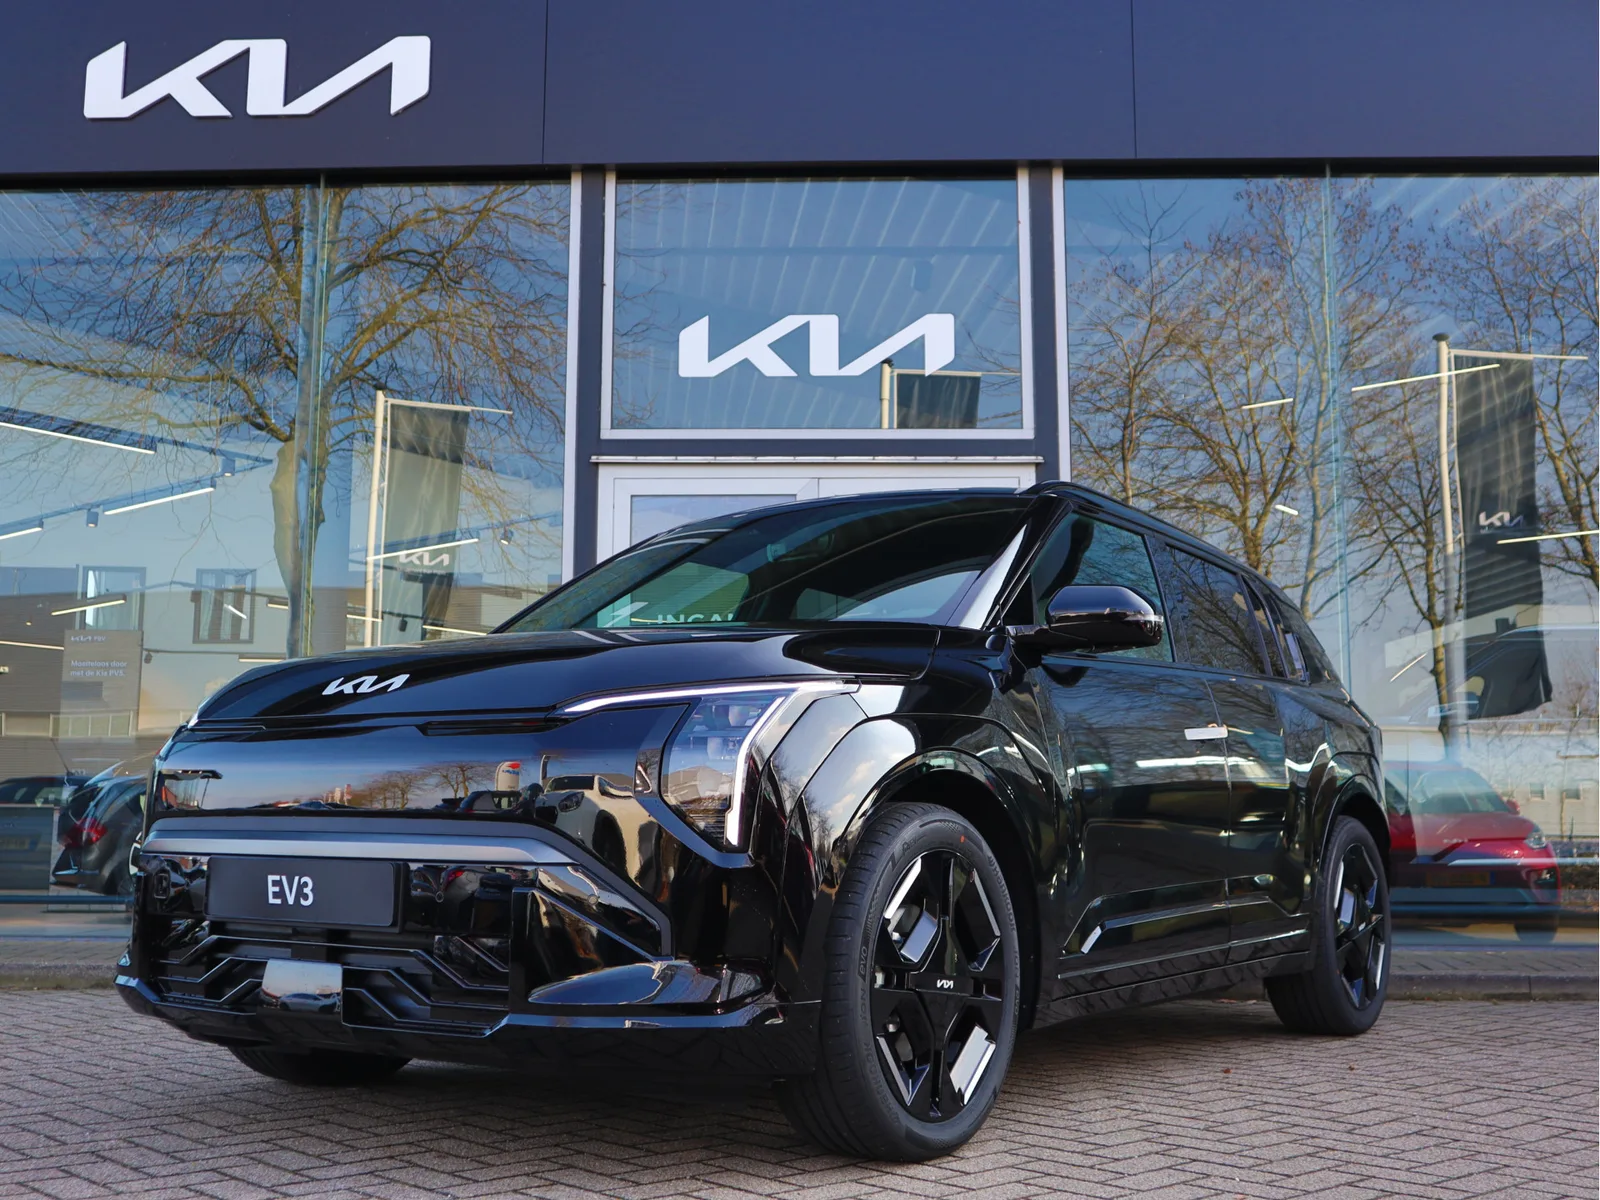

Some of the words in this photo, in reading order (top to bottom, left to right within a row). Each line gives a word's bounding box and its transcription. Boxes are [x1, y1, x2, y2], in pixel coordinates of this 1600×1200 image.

[83, 36, 431, 119] KIA
[678, 313, 955, 377] KIA
[399, 551, 450, 567] KIA
[96, 669, 108, 677] Kia
[322, 674, 410, 695] KIA
[267, 874, 313, 906] EV3
